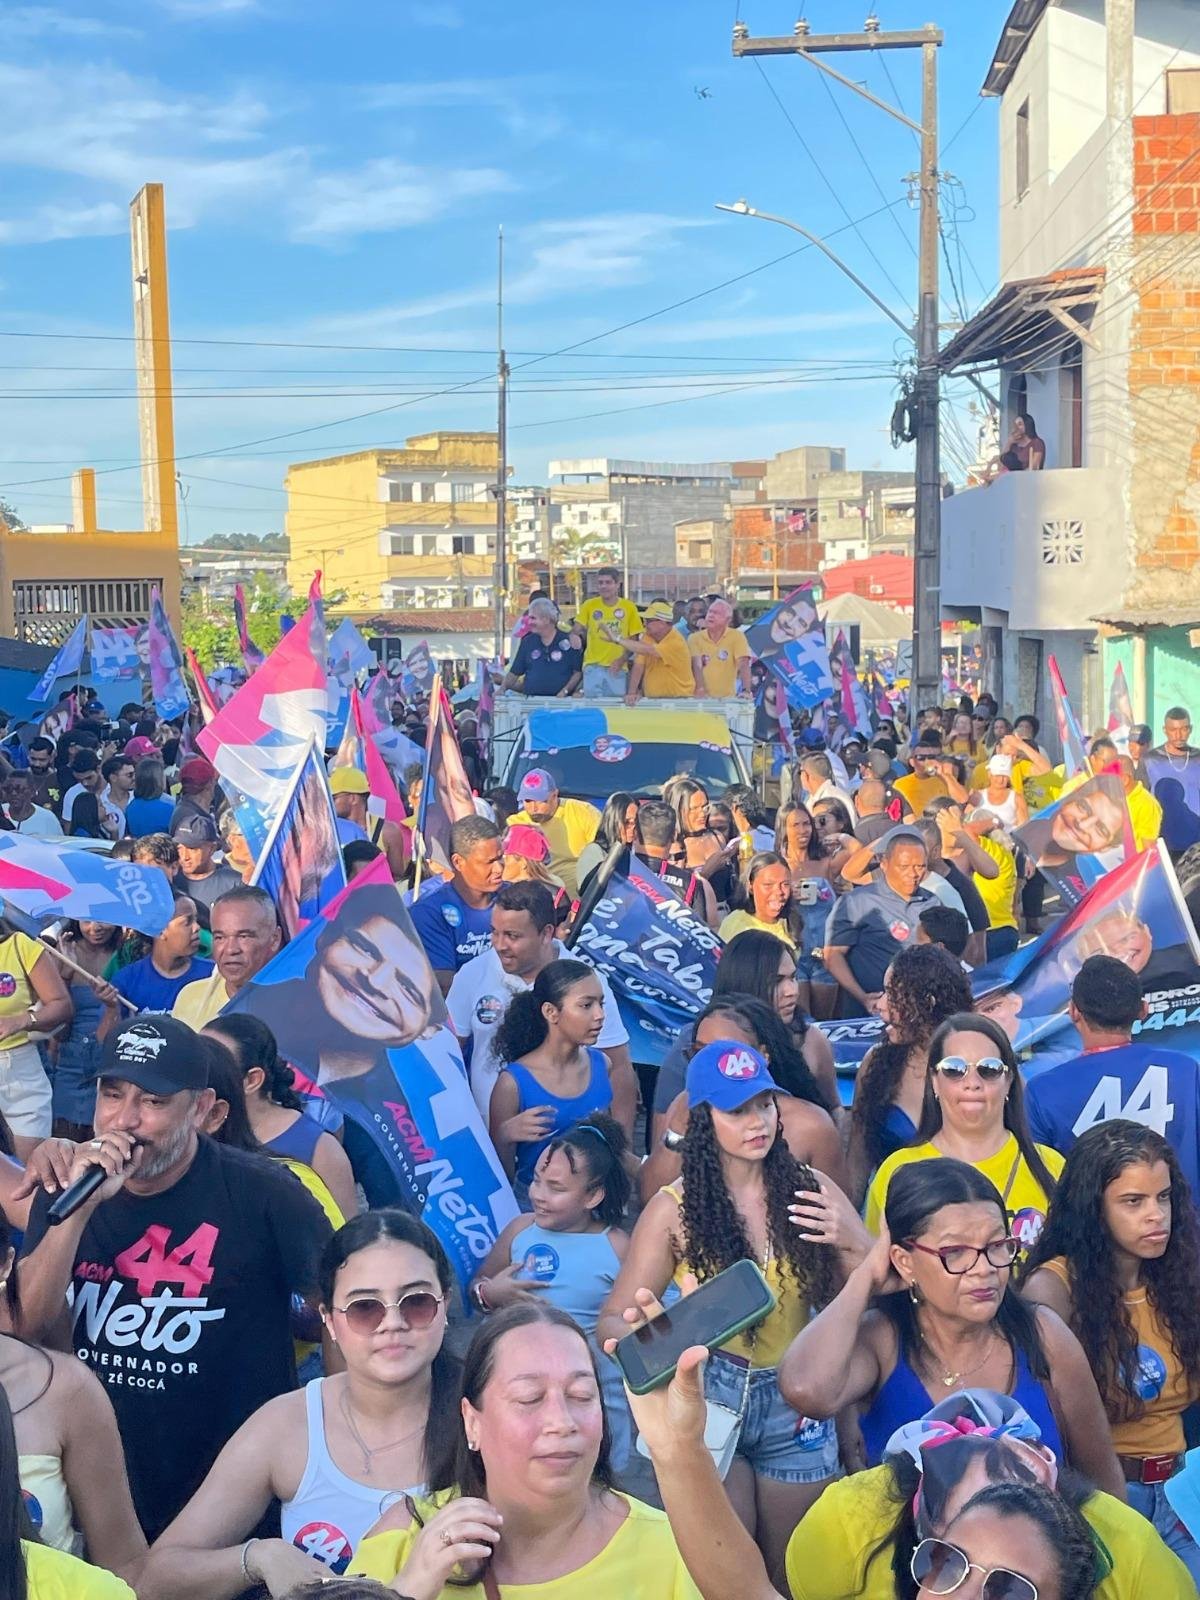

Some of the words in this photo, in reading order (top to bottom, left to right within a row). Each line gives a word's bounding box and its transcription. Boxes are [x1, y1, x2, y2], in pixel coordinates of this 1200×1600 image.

[628, 874, 667, 904] ACM
[655, 899, 723, 951] Neto
[820, 1020, 886, 1042] as
[725, 1051, 756, 1076] 44
[1071, 1064, 1175, 1138] 44
[373, 1113, 433, 1214] GOVERNADOR
[383, 1100, 436, 1163] ACM
[414, 1158, 497, 1259] Neto
[1020, 1215, 1045, 1245] 44
[74, 1261, 114, 1281] ACM
[115, 1222, 220, 1298] 44
[65, 1279, 226, 1354] Neto
[127, 1376, 166, 1390] COCÁ
[302, 1530, 347, 1567] 44
